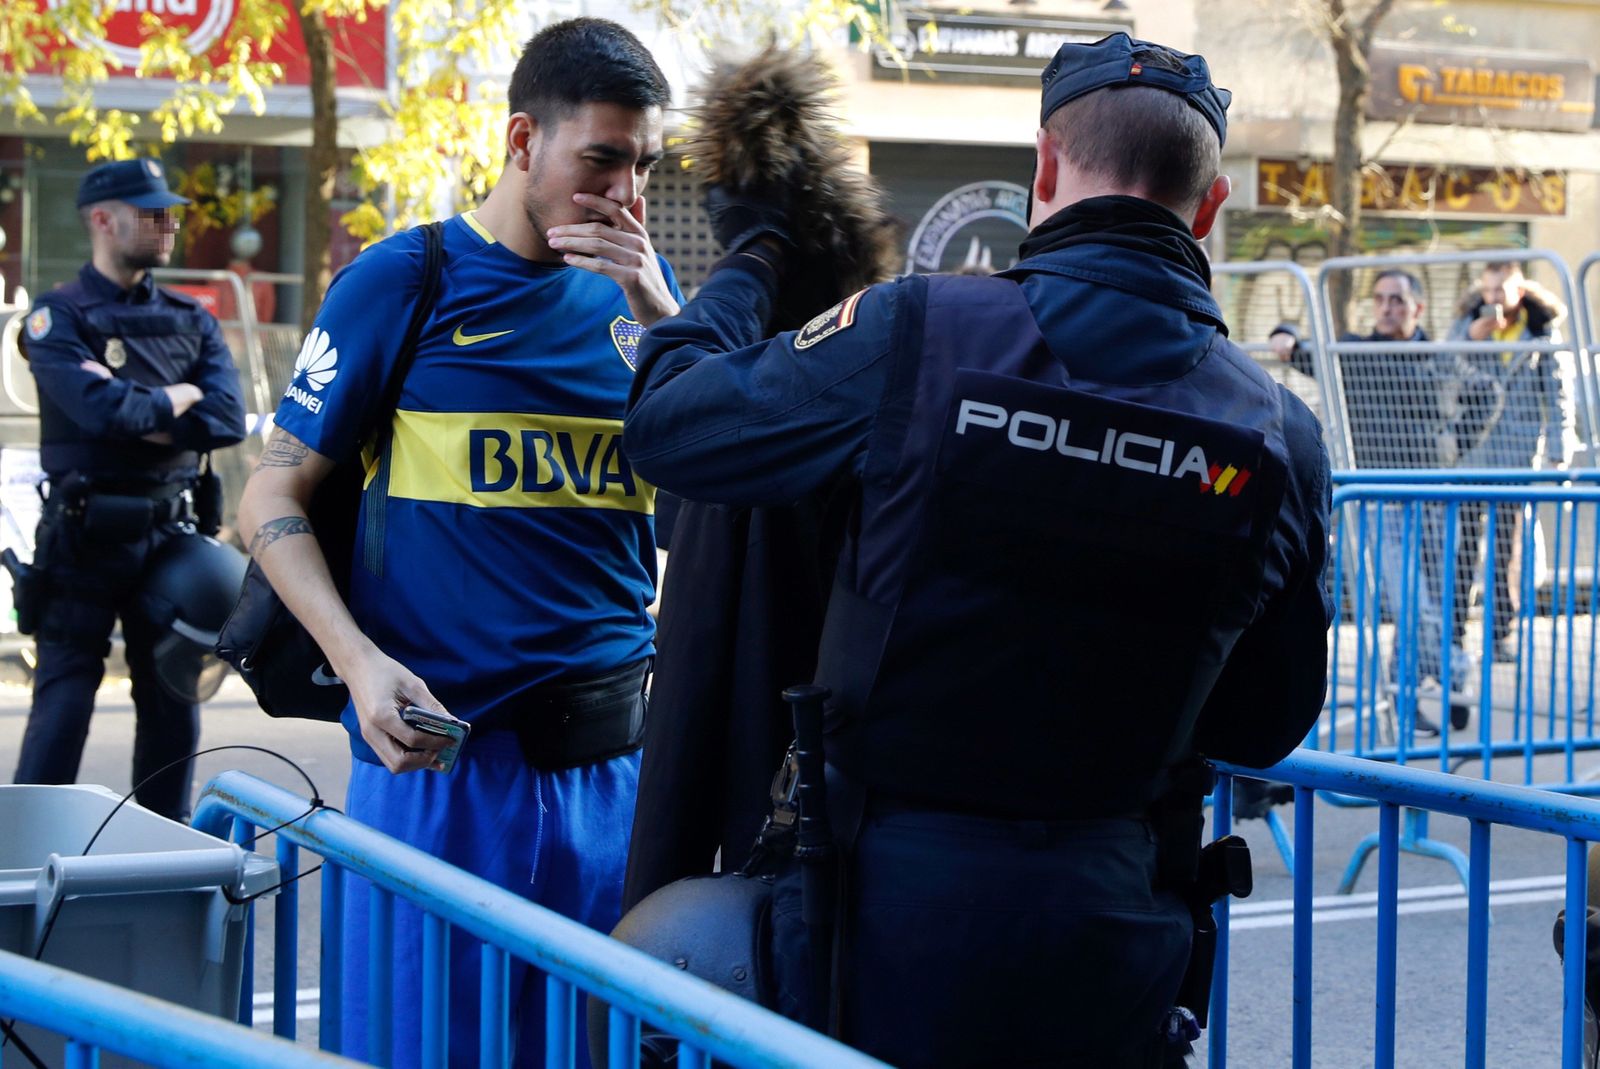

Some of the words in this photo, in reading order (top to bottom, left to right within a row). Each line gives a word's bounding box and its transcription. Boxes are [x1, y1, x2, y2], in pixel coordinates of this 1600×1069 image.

[1440, 65, 1564, 101] TABACOS
[617, 335, 641, 347] CA
[284, 382, 323, 415] AWEI
[955, 399, 1211, 484] POLICIA
[469, 429, 636, 497] BBVA
